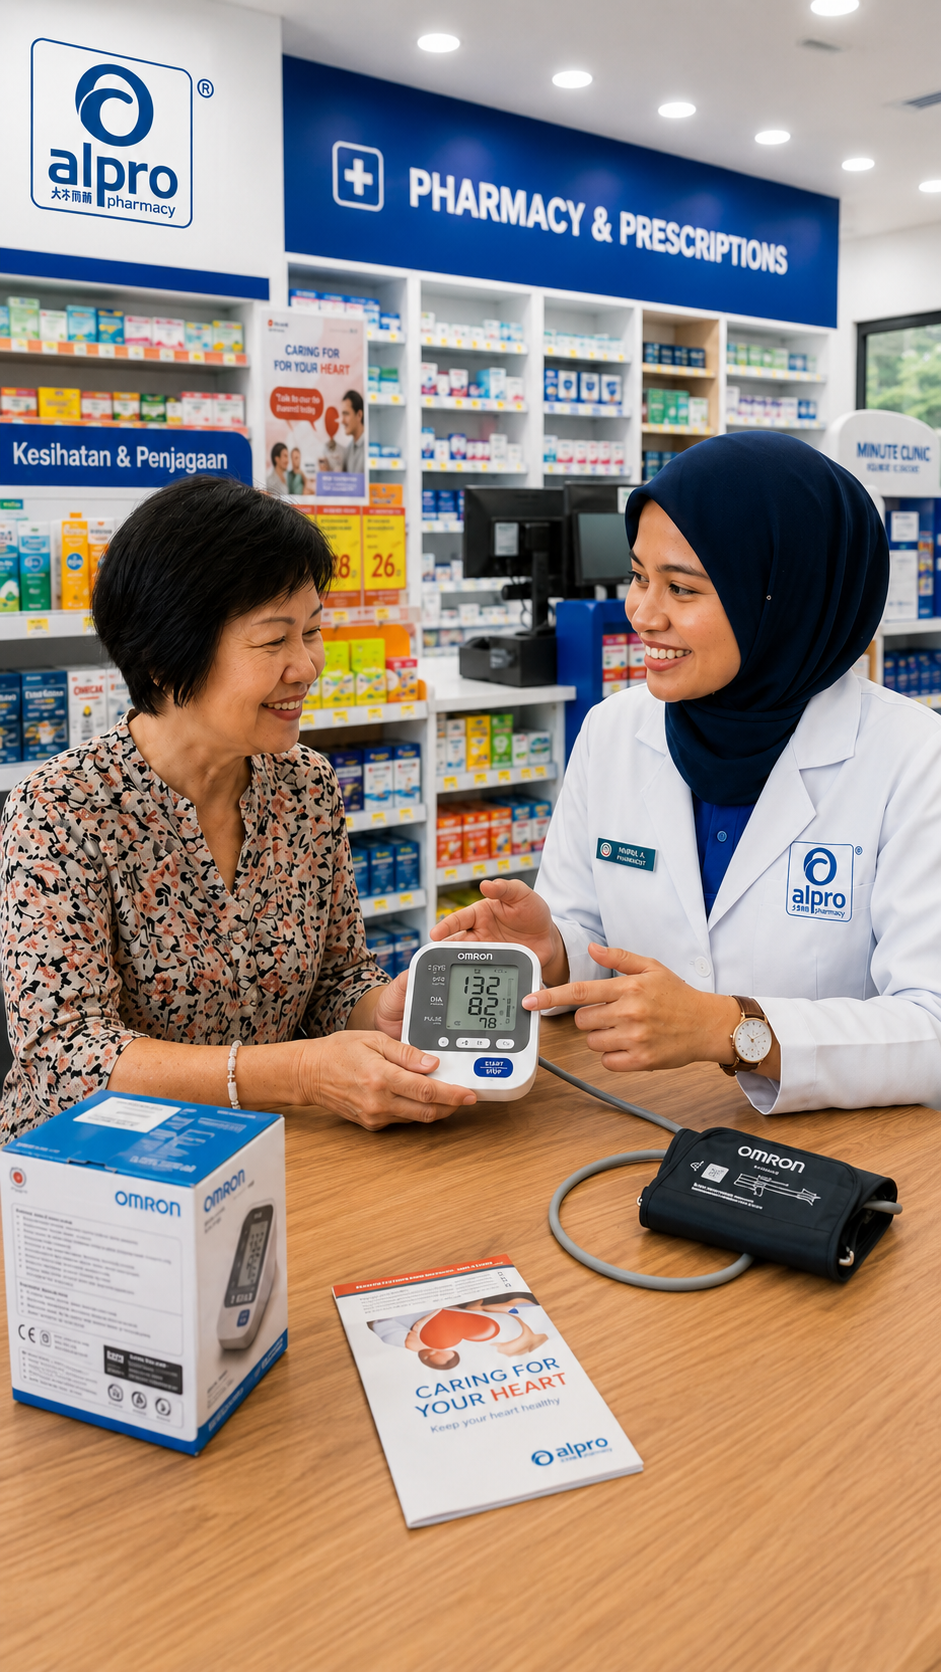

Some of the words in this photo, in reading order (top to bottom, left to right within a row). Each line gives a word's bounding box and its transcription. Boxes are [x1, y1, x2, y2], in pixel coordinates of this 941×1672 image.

[48, 142, 178, 208] alpro
[107, 195, 176, 219] pharmacy
[409, 167, 586, 237] PHARMACY
[591, 206, 613, 243] &
[620, 211, 788, 276] PRESCRIPTIONS
[285, 344, 320, 358] CARING
[322, 347, 340, 359] FOR
[274, 360, 292, 372] FOR
[294, 361, 318, 373] YOUR
[320, 363, 350, 375] HEART
[13, 441, 111, 467] Kesihatan
[116, 445, 131, 467] &
[137, 446, 228, 474] Penjagaan
[857, 442, 898, 460] MINUTE
[900, 444, 930, 462] CLINIC
[371, 553, 395, 578] 26
[792, 885, 846, 914] alpro
[457, 952, 493, 961] OMRON
[463, 976, 500, 996] 132
[468, 997, 499, 1016] 82
[479, 1018, 497, 1029] 78
[737, 1146, 806, 1174] OMRON
[114, 1190, 181, 1218] OMRON
[203, 1168, 246, 1214] OMRON
[415, 1369, 508, 1400] CARING
[512, 1357, 560, 1378] FOR
[415, 1392, 486, 1419] YOUR
[490, 1372, 567, 1402] HEART
[430, 1420, 460, 1434] Keep
[462, 1415, 488, 1429] your
[489, 1405, 519, 1420] heart
[521, 1396, 561, 1414] healthy
[555, 1438, 608, 1458] alpro
